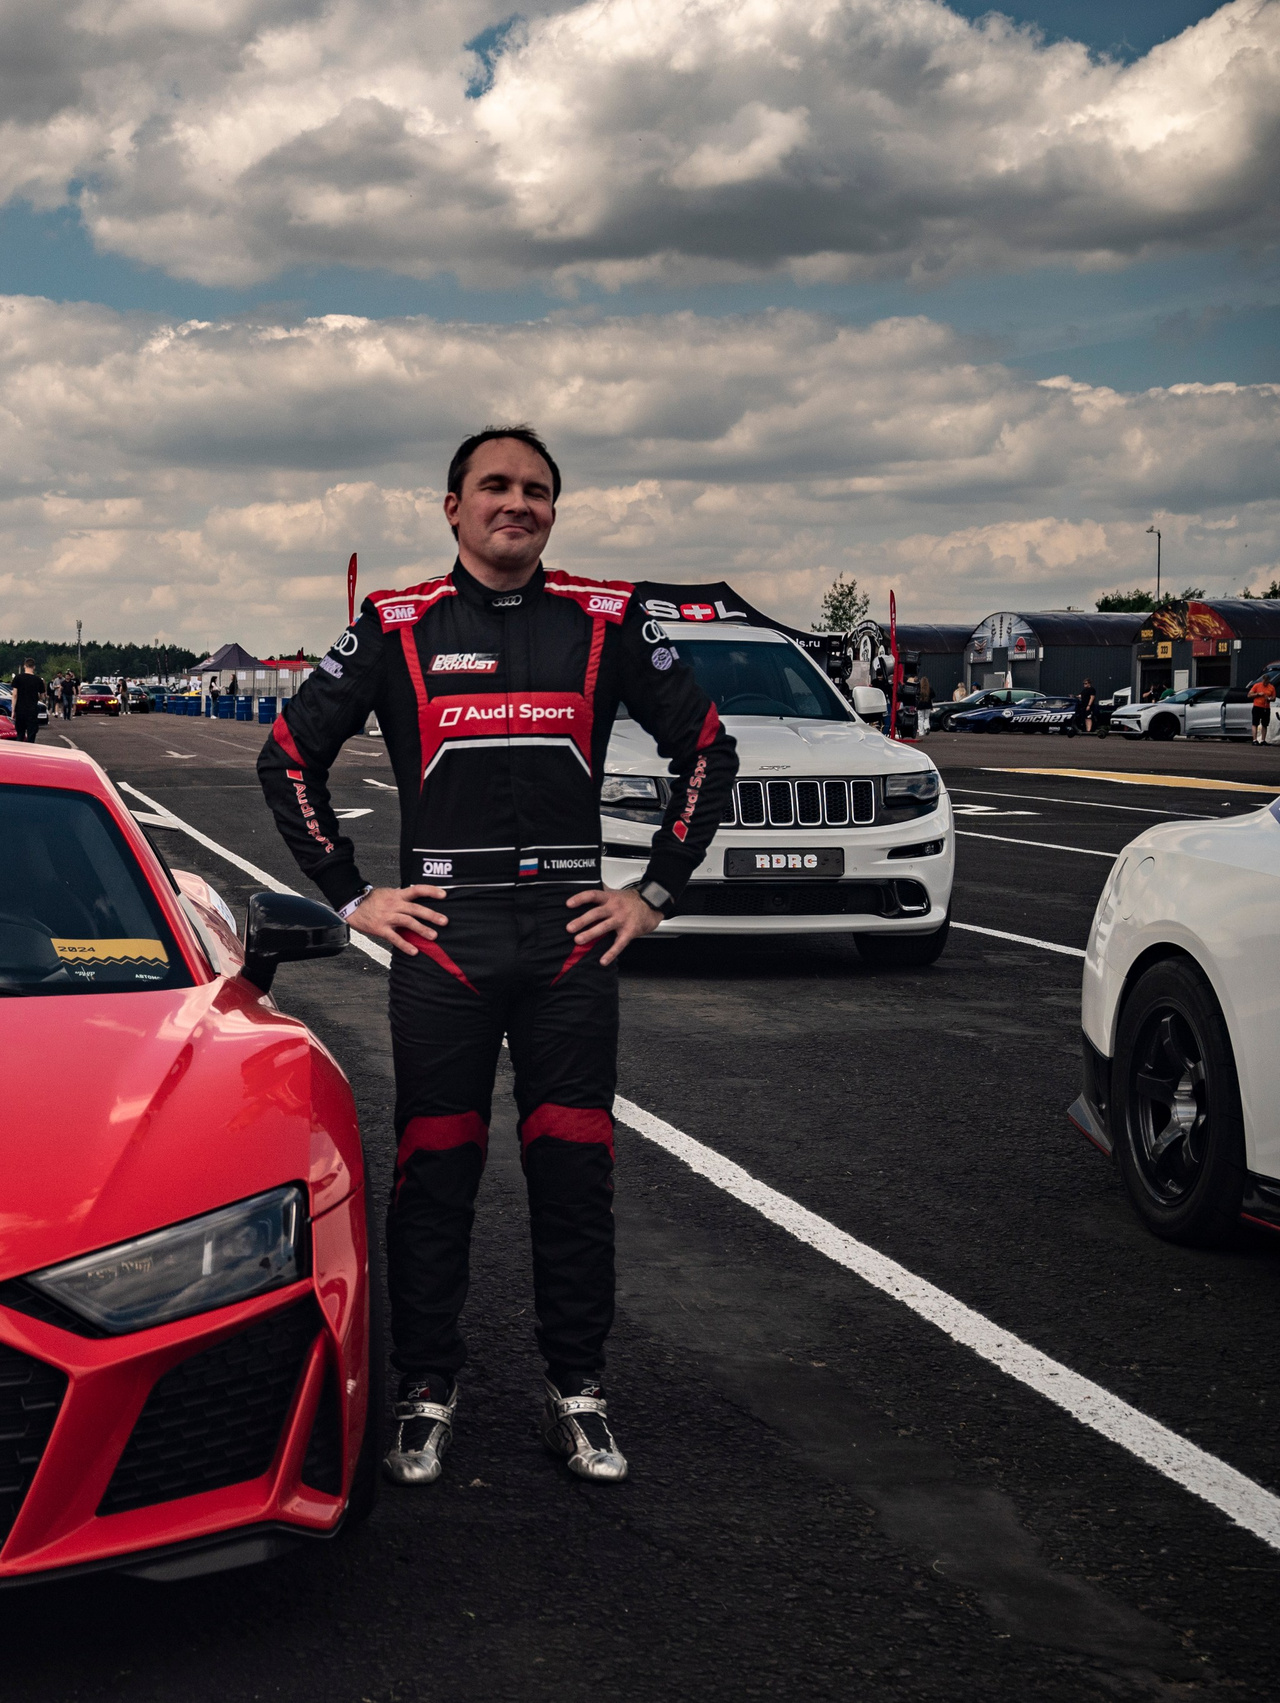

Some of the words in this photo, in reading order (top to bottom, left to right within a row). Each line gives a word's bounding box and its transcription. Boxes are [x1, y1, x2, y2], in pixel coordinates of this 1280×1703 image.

[588, 597, 623, 613] OMP
[382, 606, 417, 621] OMP
[431, 660, 497, 671] EXHAUST
[465, 704, 514, 721] Audi
[519, 703, 575, 722] Sport
[690, 755, 708, 789] Spo
[293, 783, 316, 819] Audi
[422, 861, 453, 876] OMP
[551, 858, 597, 870] TIMOSCHUK
[755, 854, 818, 869] RDRC
[57, 945, 96, 953] 2024
